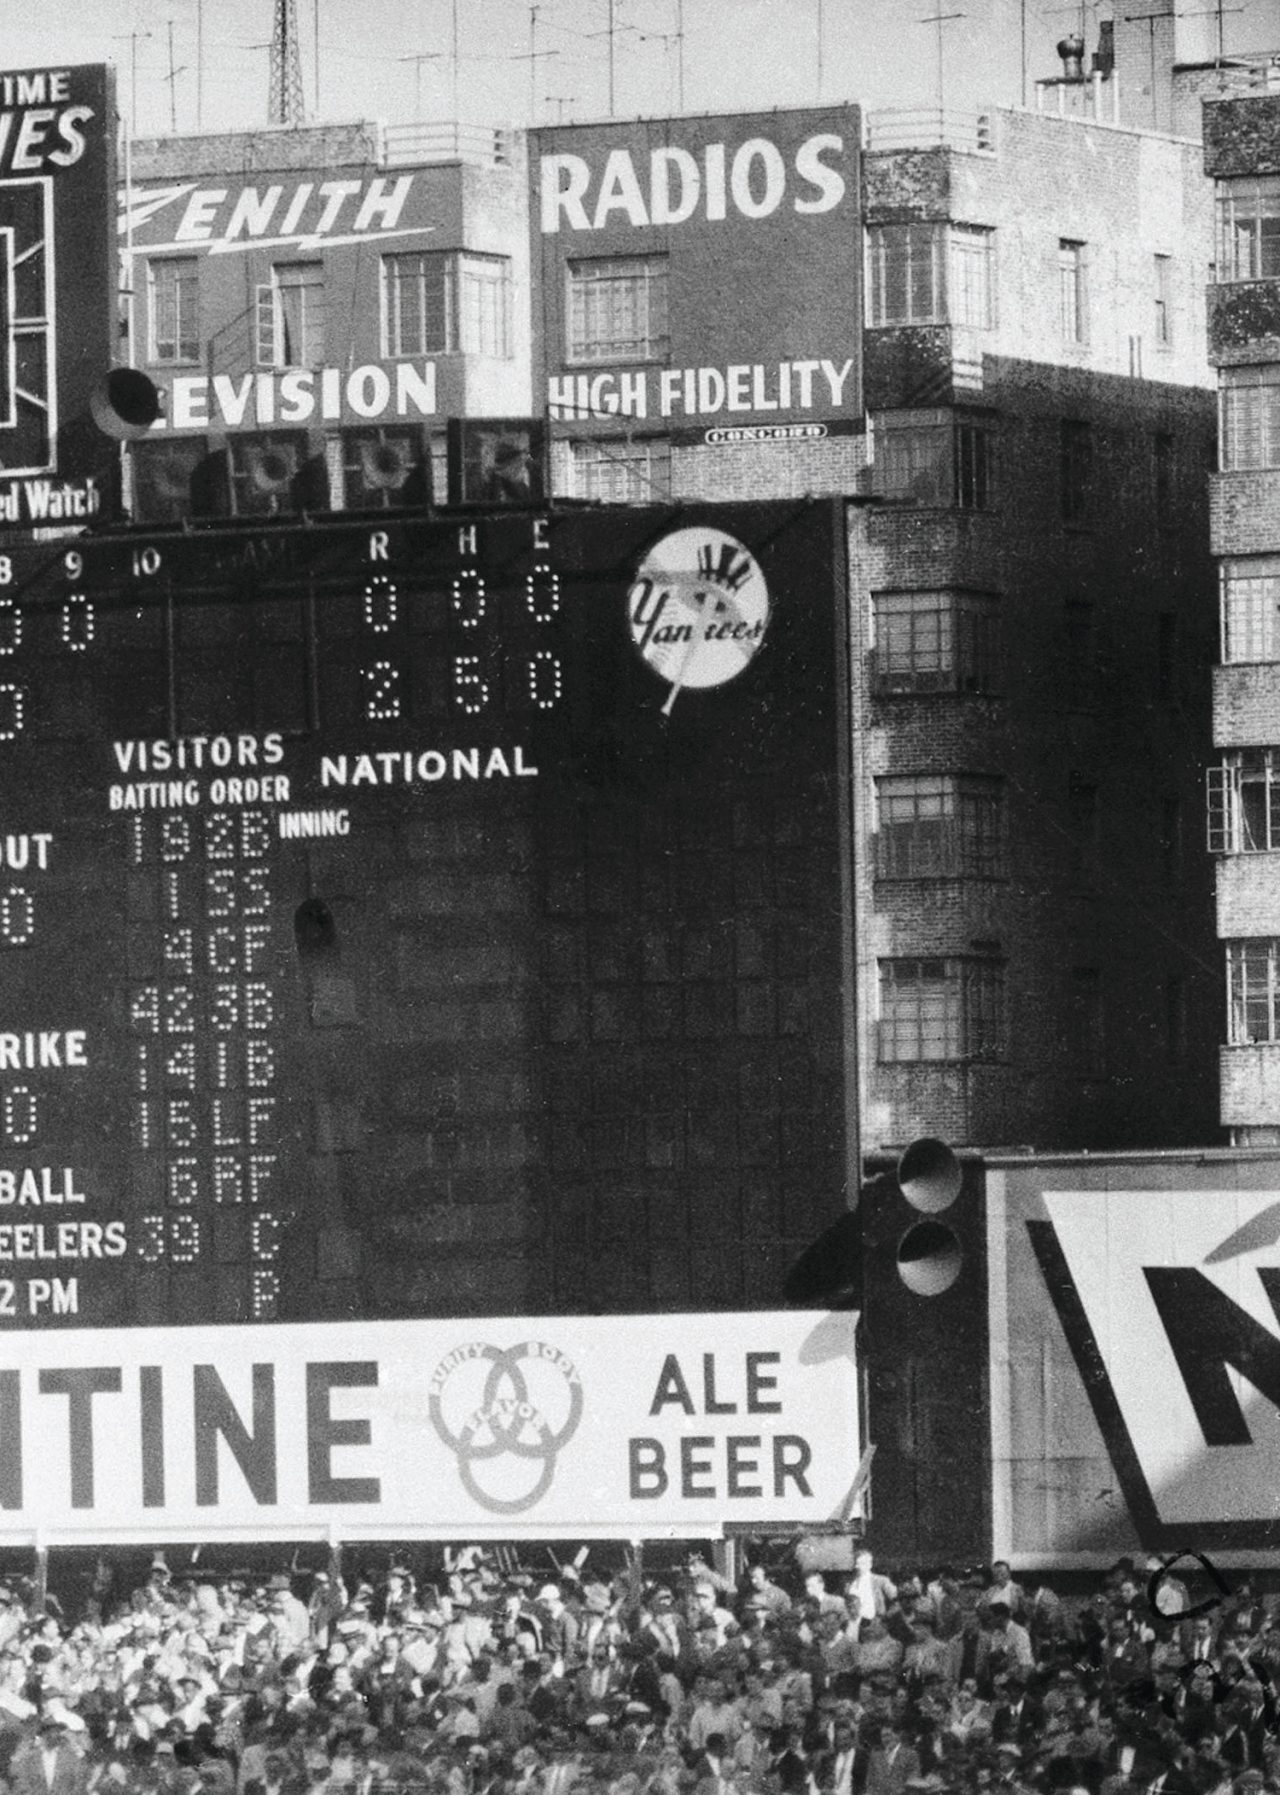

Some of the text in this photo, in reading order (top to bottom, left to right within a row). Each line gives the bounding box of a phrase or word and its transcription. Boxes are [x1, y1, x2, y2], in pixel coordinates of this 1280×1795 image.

[540, 134, 845, 233] RADIOS
[150, 361, 437, 429] EVISION
[547, 359, 853, 422] HIGH FIDELITY
[24, 477, 101, 520] Watch
[65, 552, 80, 578] 9
[133, 547, 162, 577] 10
[371, 520, 549, 560] R H E
[62, 594, 94, 651] 0
[365, 576, 397, 632] 0
[453, 570, 485, 627] 0
[527, 565, 560, 622] 0
[632, 577, 763, 649] Yanees
[367, 661, 399, 718] 2
[455, 655, 488, 713] 5
[529, 651, 561, 709] 0
[114, 734, 283, 772] VISITORS
[322, 747, 537, 786] NATIONAL
[110, 776, 289, 809] BATTING ORDER
[206, 811, 268, 858] 2B
[280, 810, 349, 838] INNING
[2, 887, 34, 944] 0
[207, 868, 270, 916] SS
[209, 926, 271, 973] CF
[132, 982, 273, 1033] 42 3B
[218, 1040, 274, 1087] 1B
[5, 1086, 37, 1143] 0
[214, 1098, 276, 1145] LF
[171, 1155, 277, 1204] 6 RF
[136, 1213, 280, 1263] 39 C
[29, 1278, 78, 1315] PM
[253, 1271, 280, 1316] P
[649, 1351, 783, 1416] ALE
[628, 1434, 814, 1500] BEER
